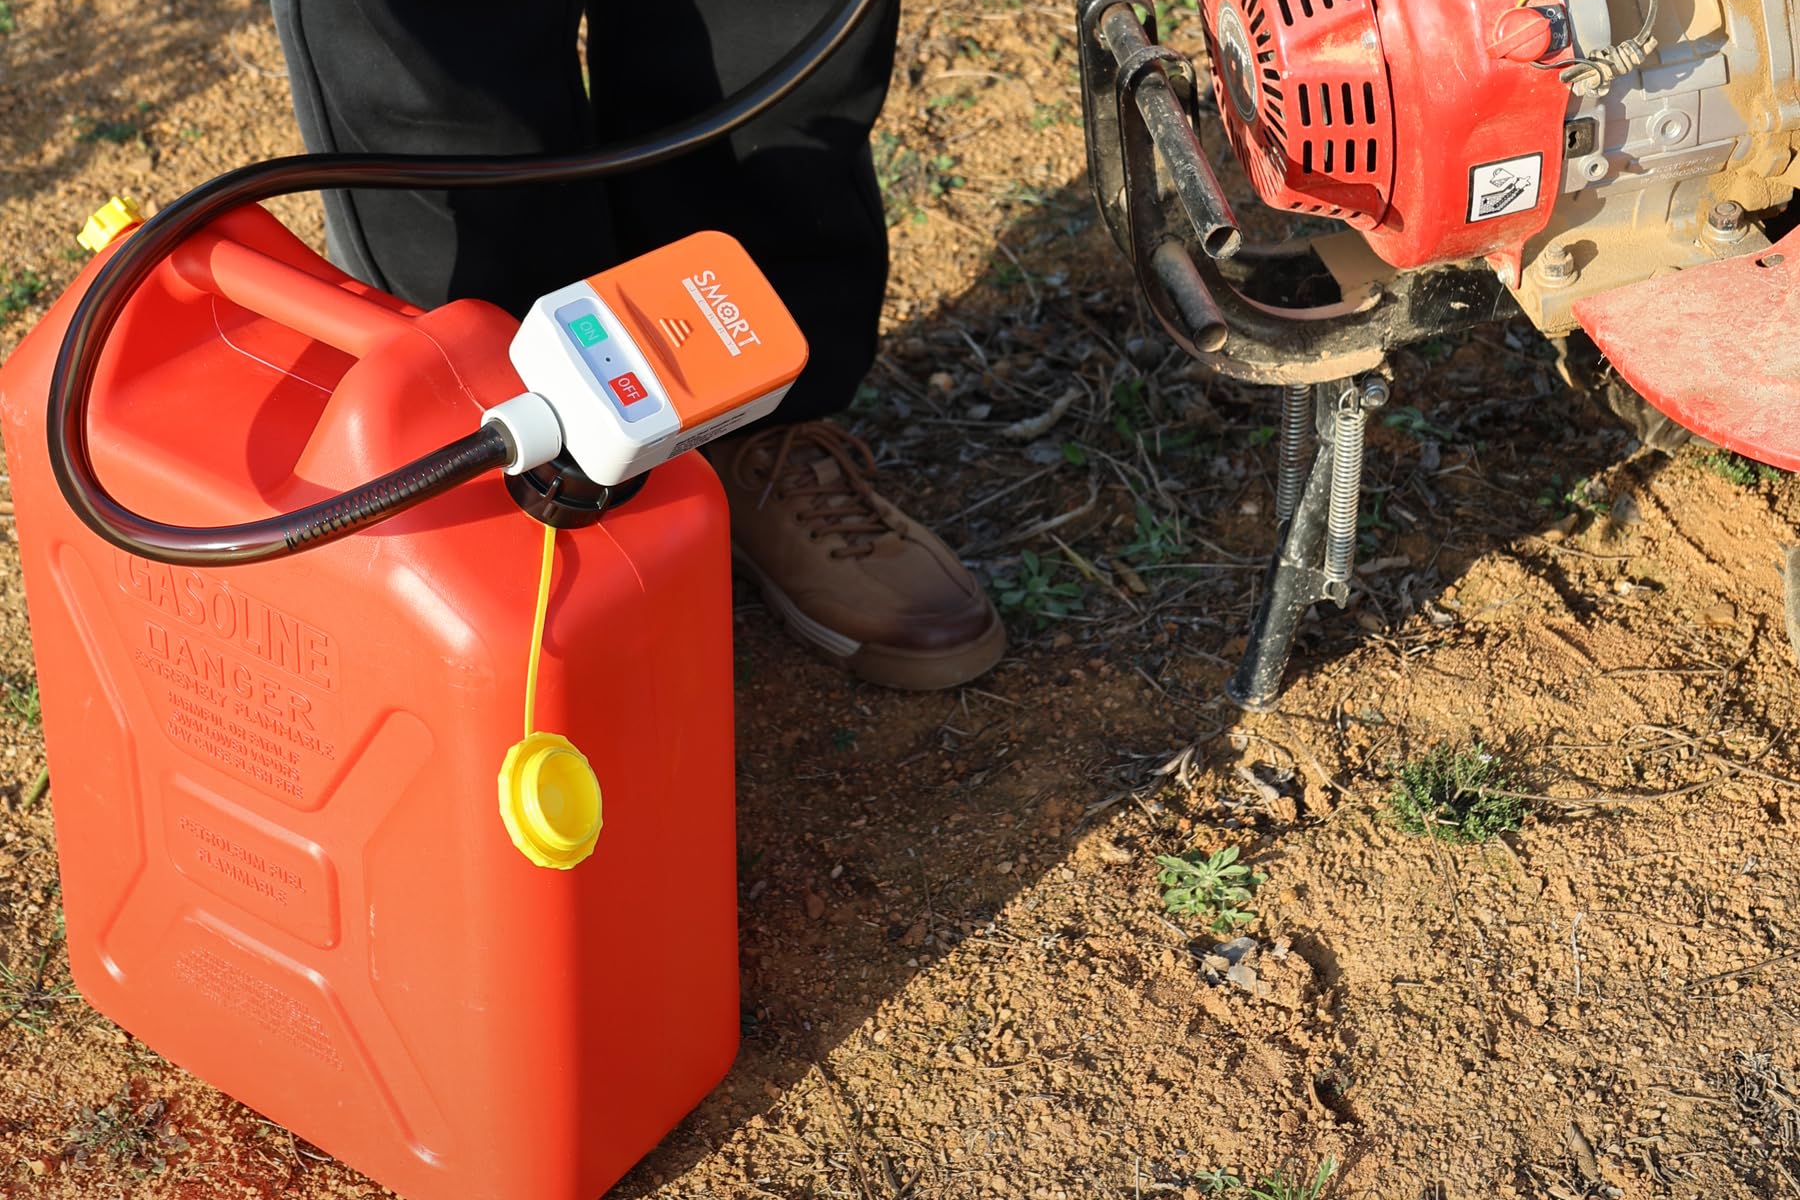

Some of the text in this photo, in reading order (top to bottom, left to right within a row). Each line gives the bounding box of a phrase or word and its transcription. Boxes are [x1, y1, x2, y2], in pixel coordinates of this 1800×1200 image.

[580, 320, 600, 340] ON
[693, 270, 761, 347] SMART
[617, 377, 640, 399] OFF
[128, 555, 332, 690] GASOLINE
[135, 646, 336, 761] EXTREMELY FLAMMABLE
[145, 619, 316, 731] DANGER
[178, 815, 306, 894] PETROLEUM FUEL
[198, 847, 288, 906] FLAMMABLE
